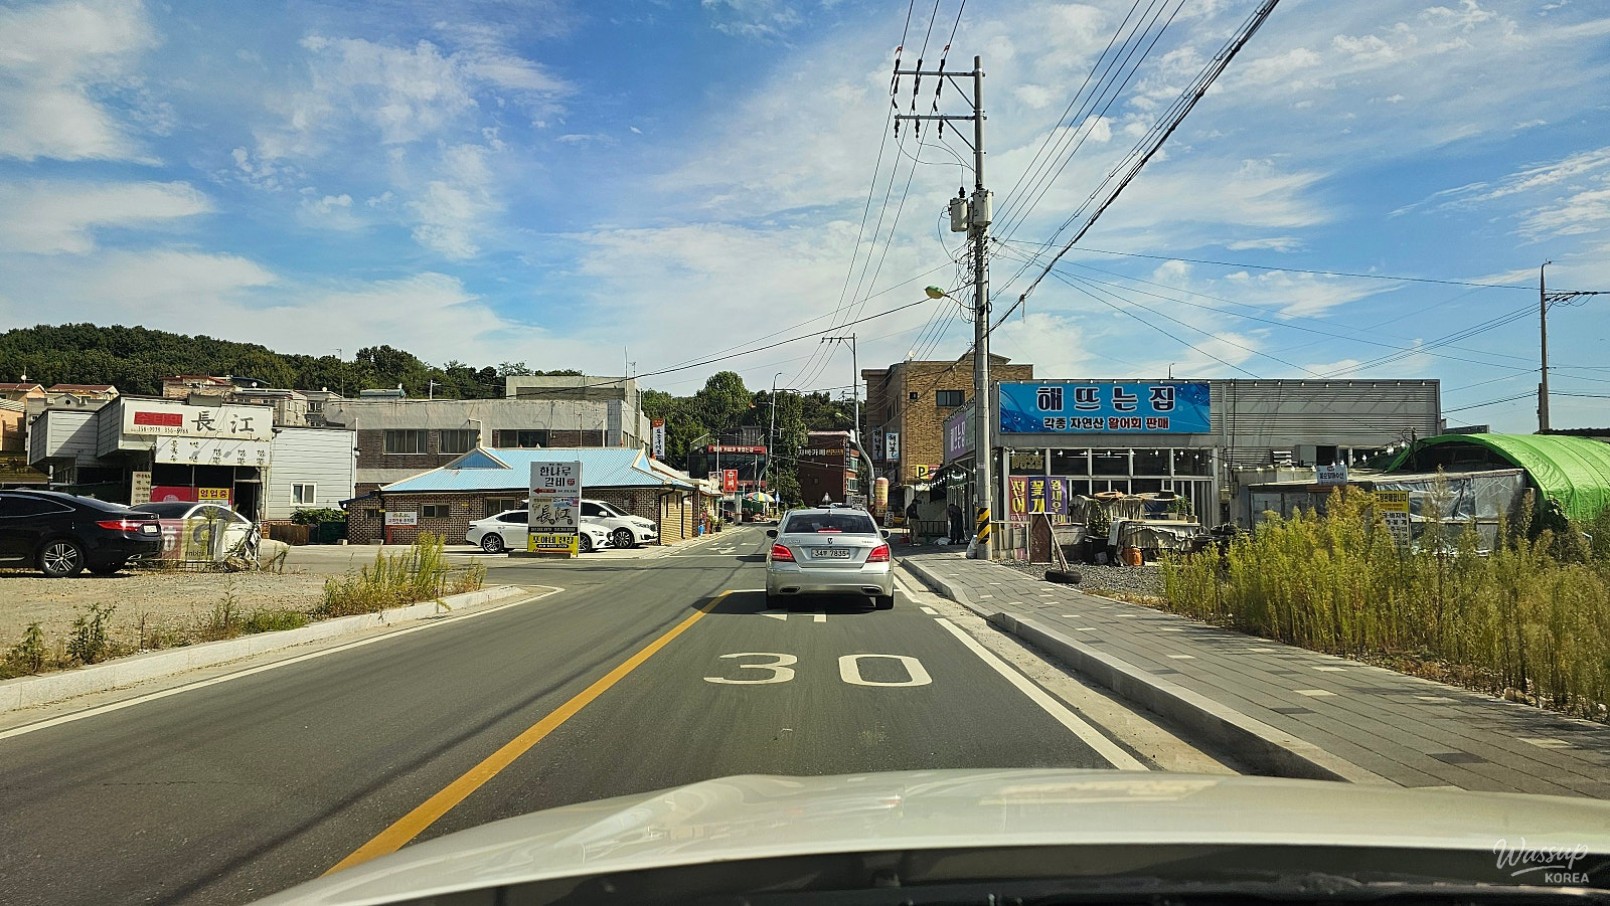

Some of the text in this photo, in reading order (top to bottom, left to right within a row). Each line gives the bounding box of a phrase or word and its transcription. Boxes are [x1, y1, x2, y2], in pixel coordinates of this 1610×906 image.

[191, 411, 255, 433] 長江
[1043, 417, 1170, 430] 각종 자연산 활어회 판매
[540, 466, 571, 476] 한나루
[200, 489, 227, 498] 영업중
[703, 652, 933, 687] 30
